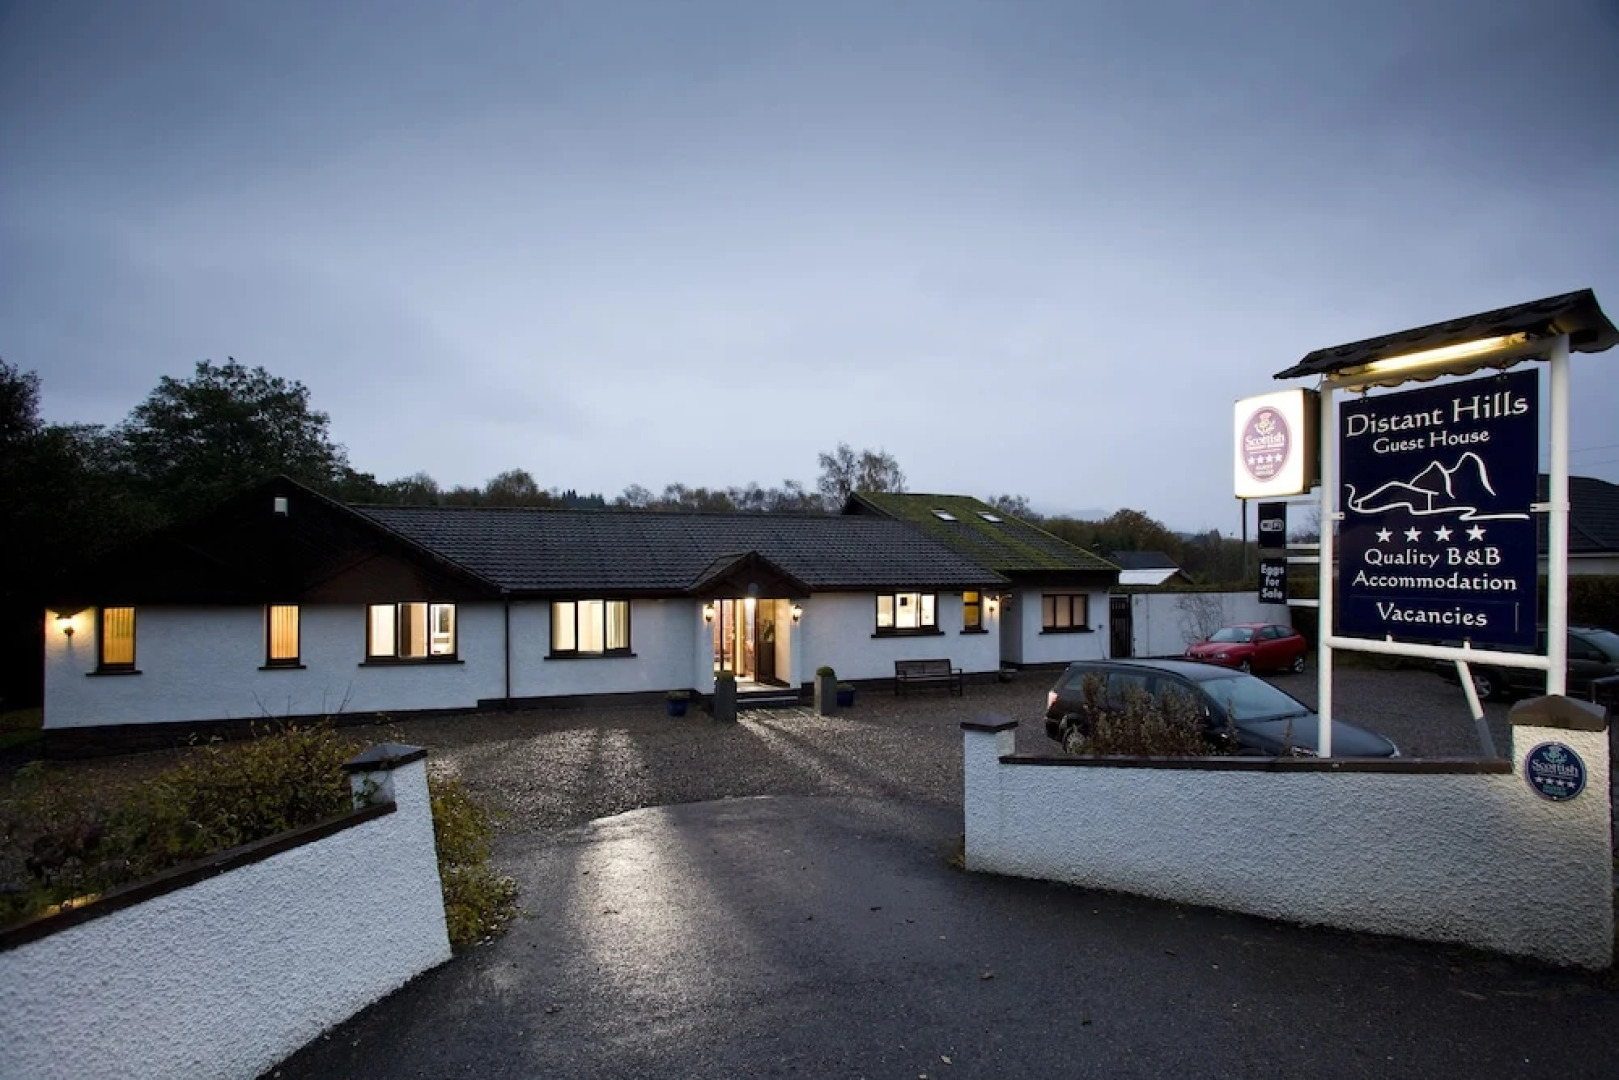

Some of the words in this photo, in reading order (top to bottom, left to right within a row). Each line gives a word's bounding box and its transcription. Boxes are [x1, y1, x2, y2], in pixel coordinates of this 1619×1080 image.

[1346, 407, 1443, 438] Distant
[1453, 391, 1529, 423] Hills
[1373, 437, 1425, 454] Guest
[1430, 429, 1490, 448] House
[1364, 548, 1440, 568] Quality
[1446, 547, 1501, 565] B&B
[1260, 563, 1284, 577] Eggs
[1352, 570, 1517, 591] Accommodation
[1264, 576, 1280, 587] for
[1262, 587, 1283, 599] Sale
[1376, 602, 1488, 626] Vacancies
